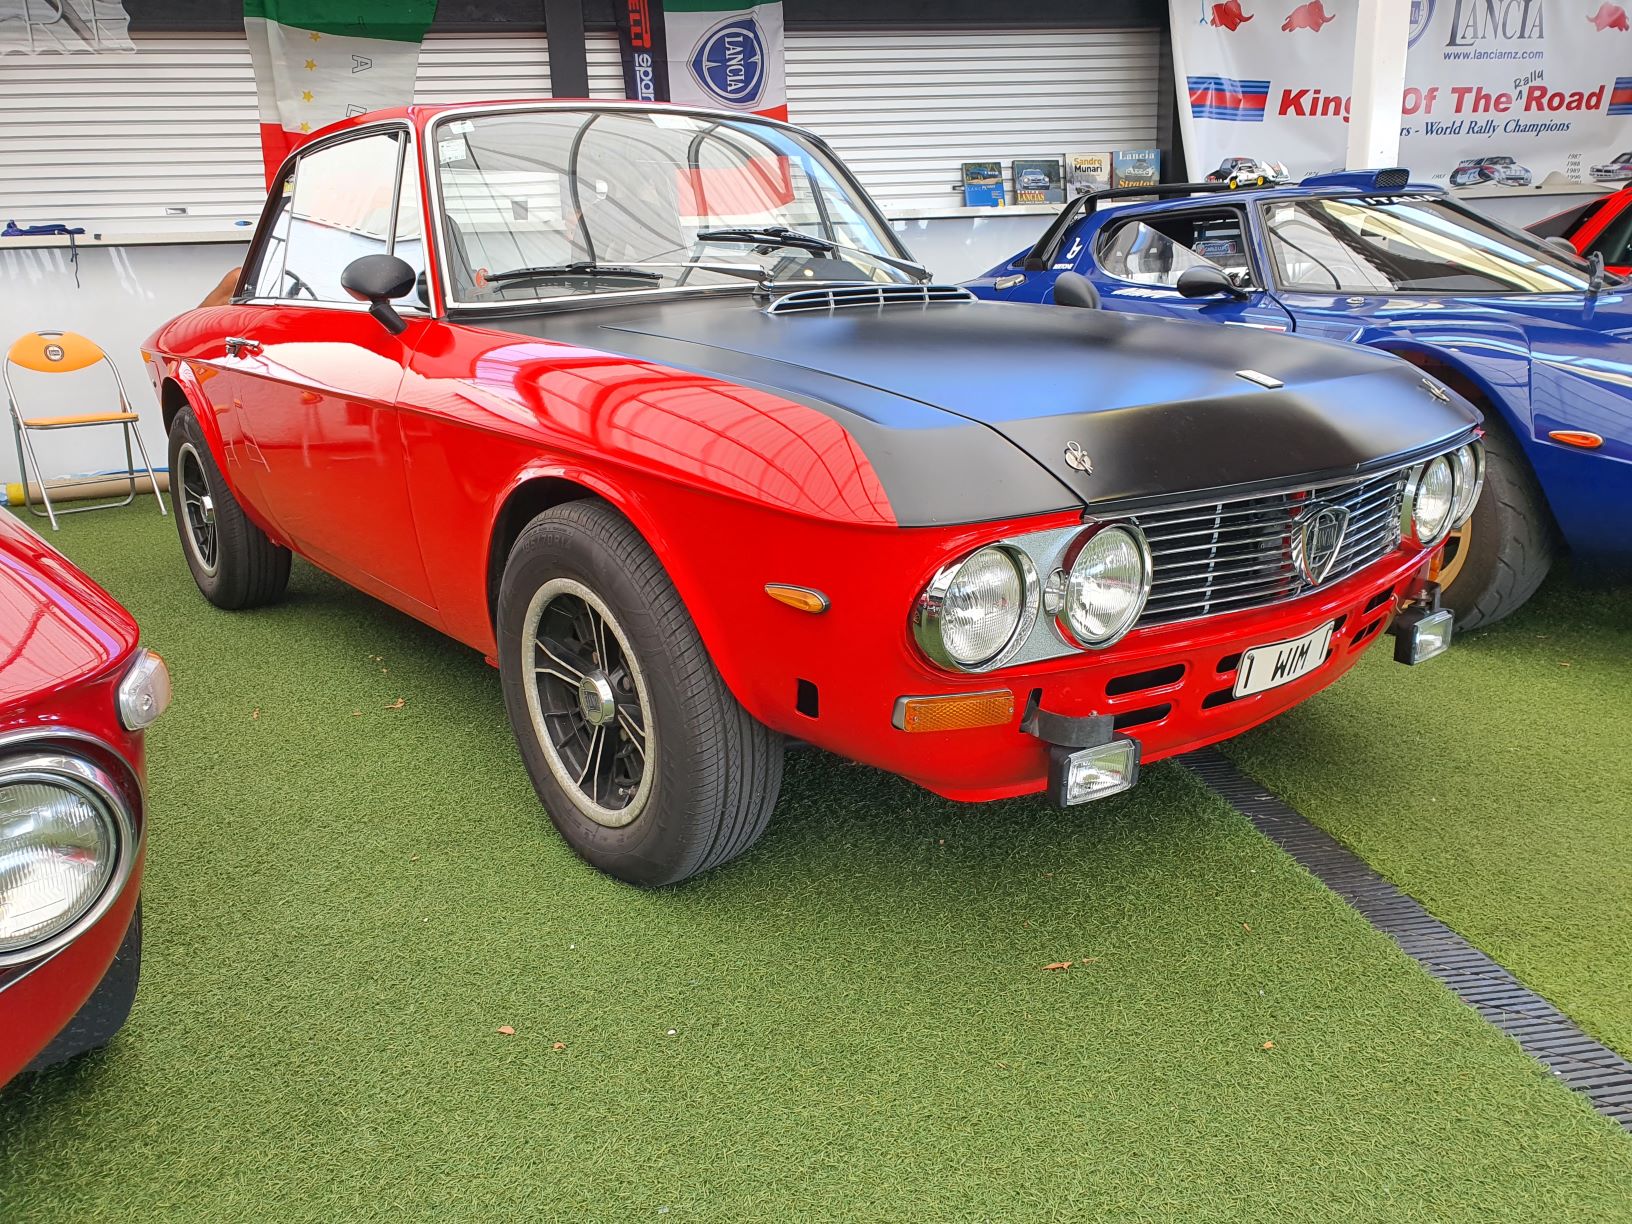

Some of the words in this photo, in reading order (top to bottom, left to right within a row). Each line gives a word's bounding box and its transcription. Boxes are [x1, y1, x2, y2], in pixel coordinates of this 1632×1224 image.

[1445, 0, 1545, 47] LANCIA
[724, 36, 745, 92] LANCIA
[634, 53, 655, 101] spar
[1513, 69, 1544, 90] Rally
[1402, 86, 1439, 115] Of
[1451, 86, 1513, 114] The
[1524, 85, 1606, 112] Road
[1424, 120, 1464, 136] World
[1467, 120, 1499, 139] Rally
[1504, 119, 1571, 137] Champions
[1074, 158, 1103, 166] Sandro
[1119, 150, 1155, 160] Lancia
[1074, 165, 1103, 173] Munari
[1270, 639, 1313, 682] WIM
